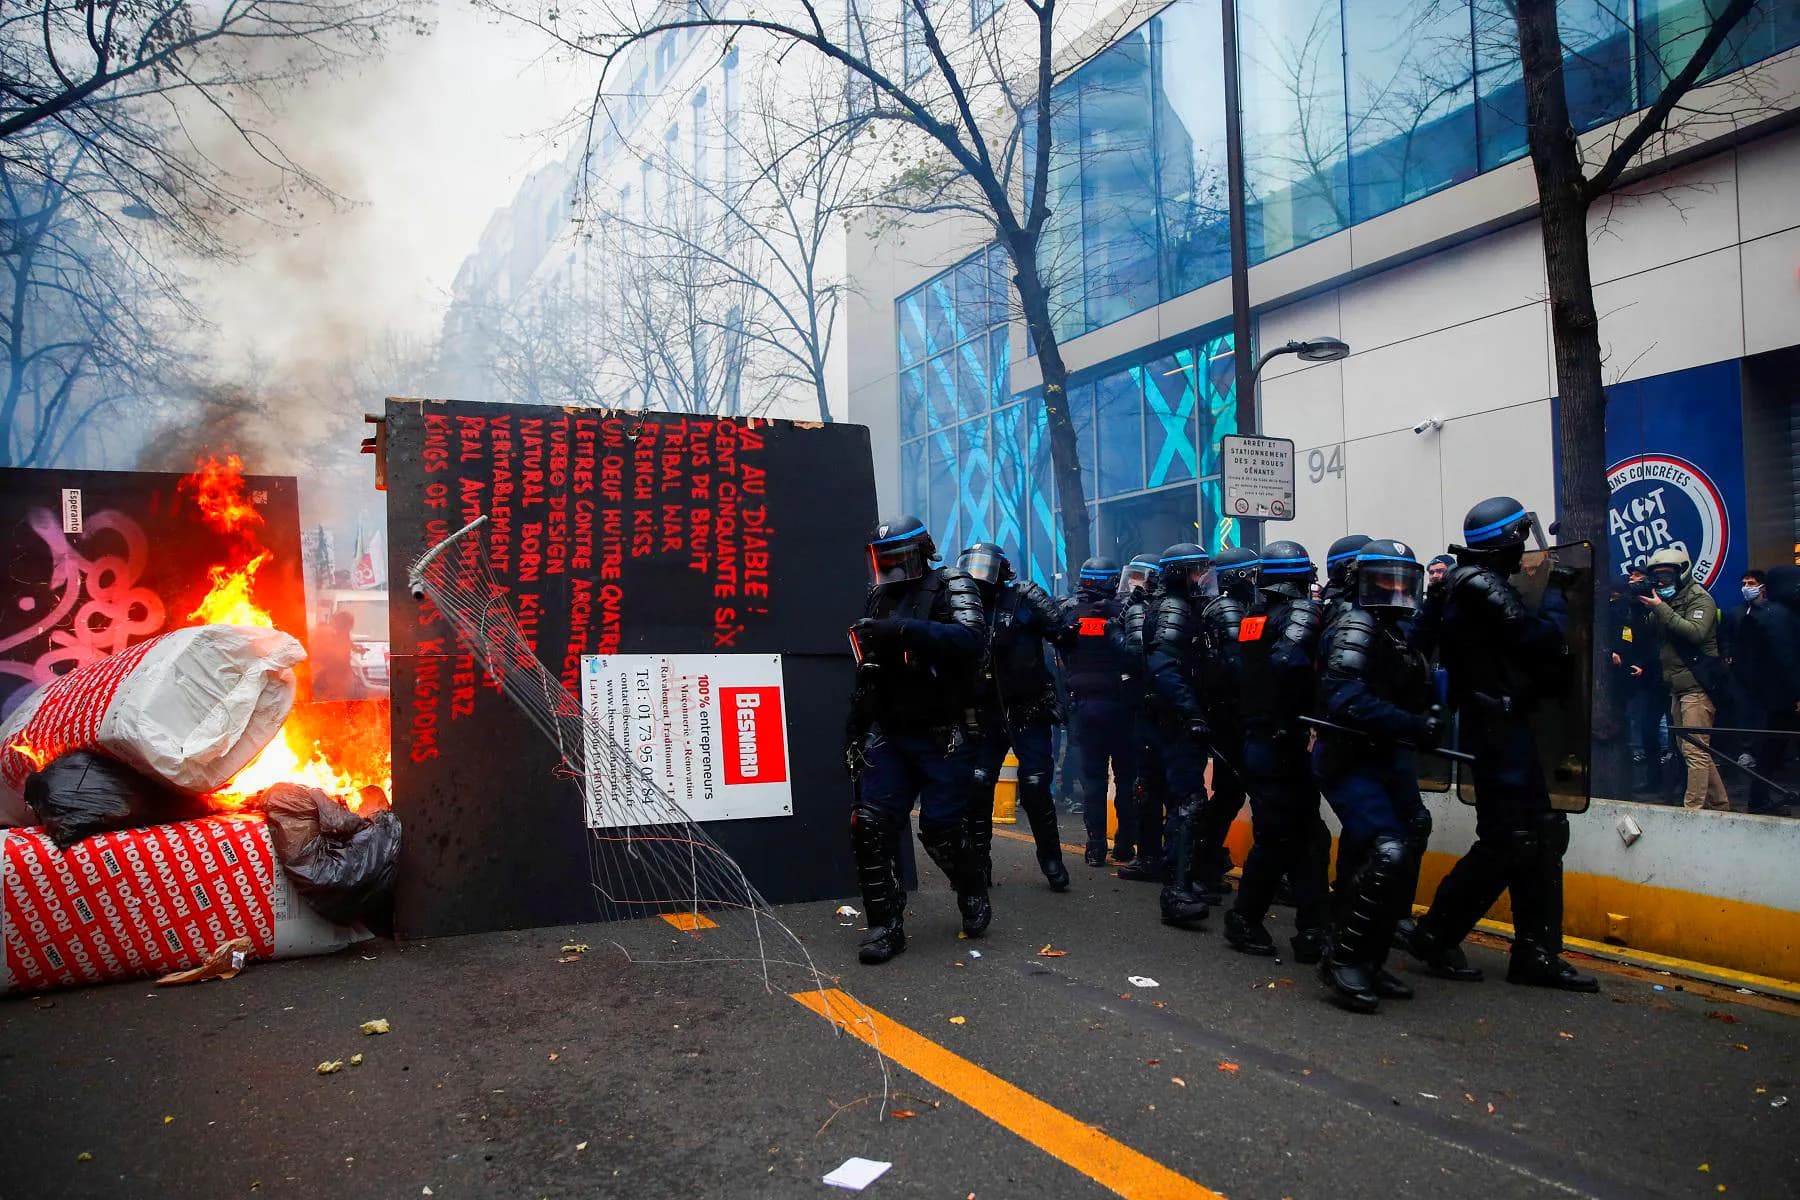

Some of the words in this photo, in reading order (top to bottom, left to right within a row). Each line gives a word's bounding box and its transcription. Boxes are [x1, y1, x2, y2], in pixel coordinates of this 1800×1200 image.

[456, 415, 485, 462] REAL
[549, 416, 569, 486] TURBO
[601, 420, 624, 447] UN
[690, 421, 713, 467] PLUS
[716, 421, 737, 475] CENT
[1230, 448, 1287, 458] STATIONNEMENT
[520, 418, 543, 507] NATURAL
[691, 473, 710, 499] DE
[740, 464, 765, 494] AU
[1309, 445, 1344, 484] 94
[68, 490, 80, 532] Esperanto
[425, 483, 448, 508] OF
[518, 523, 542, 581] BORN
[571, 500, 596, 569] CONTRE
[661, 504, 682, 552] WAR
[1619, 518, 1673, 558] FOR
[590, 679, 597, 690] La
[636, 669, 649, 691] Tél
[660, 666, 670, 719] Ravalement
[638, 704, 651, 720] 01
[639, 726, 652, 741] 73
[680, 684, 690, 736] Maçonnerie
[641, 746, 652, 762] 95
[664, 722, 674, 778] Traditionnel
[699, 711, 714, 799] entrepreneurs
[736, 693, 760, 777] BESNARD
[642, 788, 654, 804] 84
[684, 749, 694, 799] Rénovation
[71, 842, 101, 886] ROCK
[105, 851, 120, 873] roche
[122, 841, 171, 928] ROCKWOOL
[143, 833, 190, 918] ROCKWOOL
[3, 854, 51, 943] ROCKWOOL
[19, 845, 72, 933] ROCKWOOL
[195, 885, 210, 907] roche
[212, 874, 257, 952] CKWOOL
[232, 866, 274, 947] ROCKWOOL
[96, 886, 143, 968] ROCKWOOL
[116, 876, 162, 960] ROCKWOOL
[4, 911, 42, 979] ROCKWO
